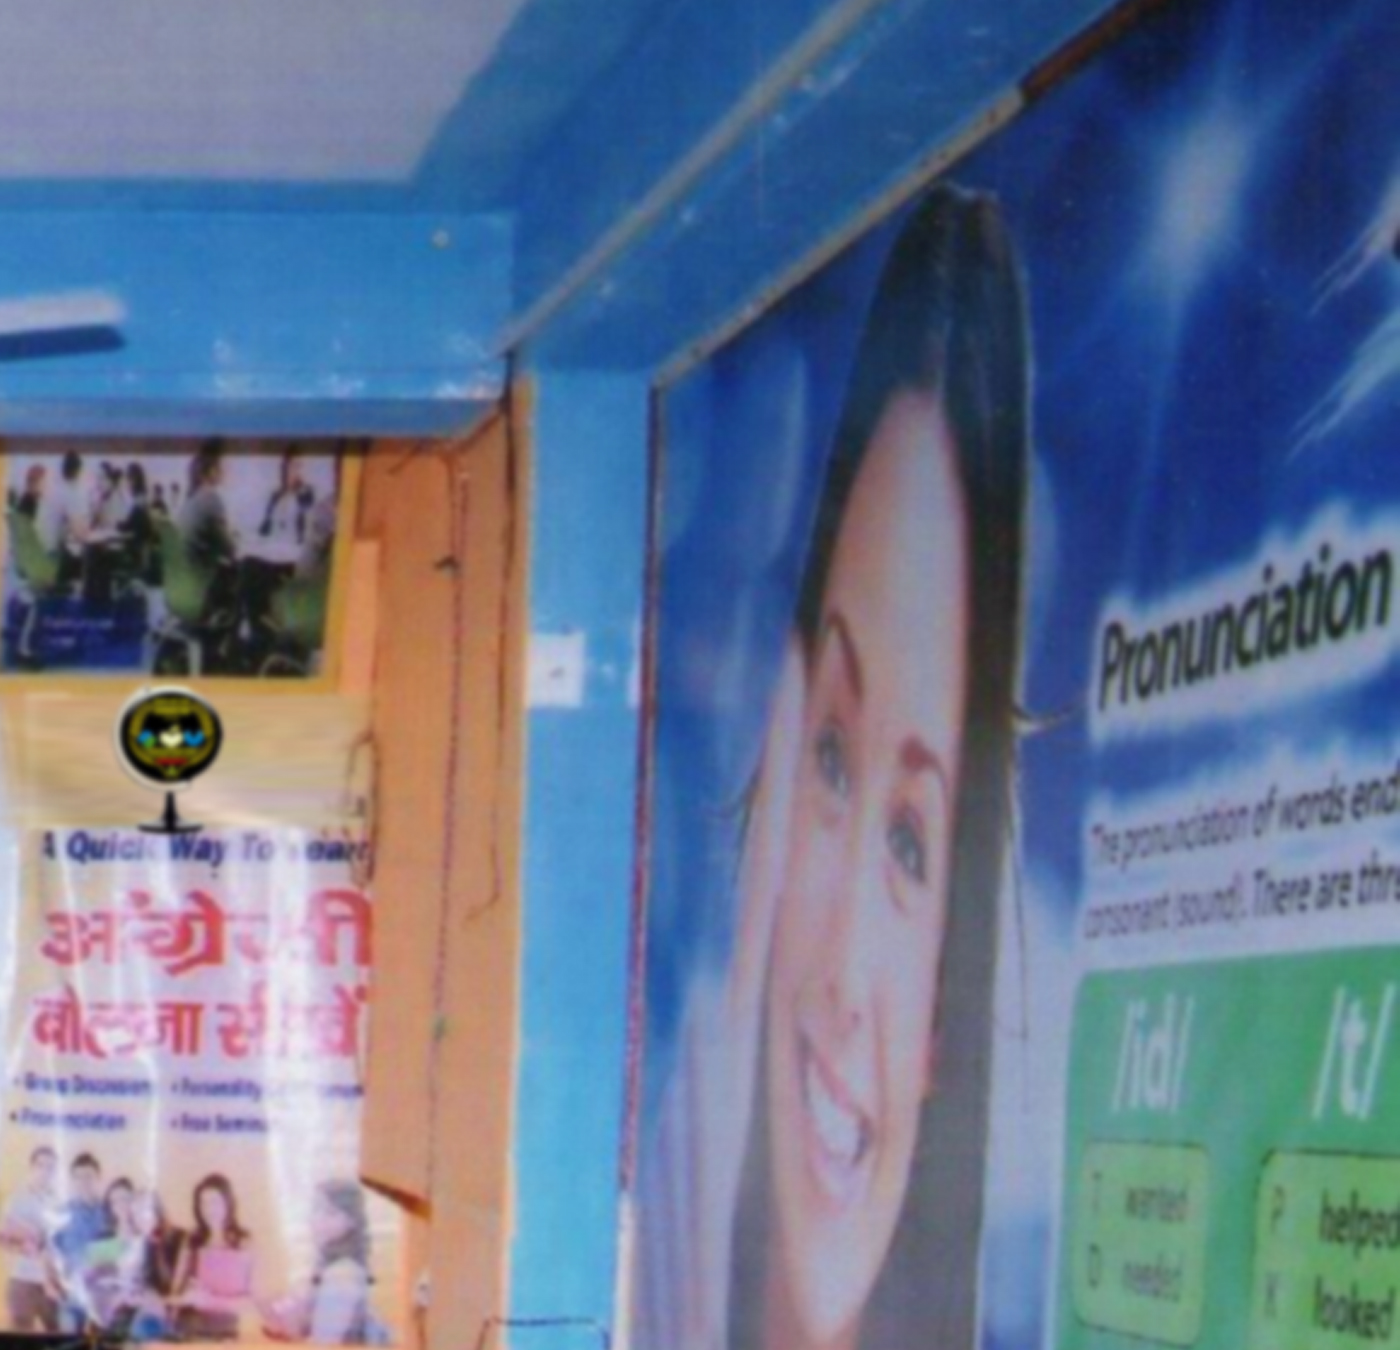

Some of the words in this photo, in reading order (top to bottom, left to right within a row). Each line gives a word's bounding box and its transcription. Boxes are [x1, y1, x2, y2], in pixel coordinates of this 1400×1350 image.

[1099, 542, 1395, 712] Pronunciation
[1252, 782, 1279, 838] of
[1280, 770, 1347, 832] words
[169, 832, 224, 868] Way
[1254, 866, 1313, 918] There
[1316, 870, 1353, 911] are
[1317, 1186, 1400, 1263] helped
[1312, 1272, 1396, 1343] looked
